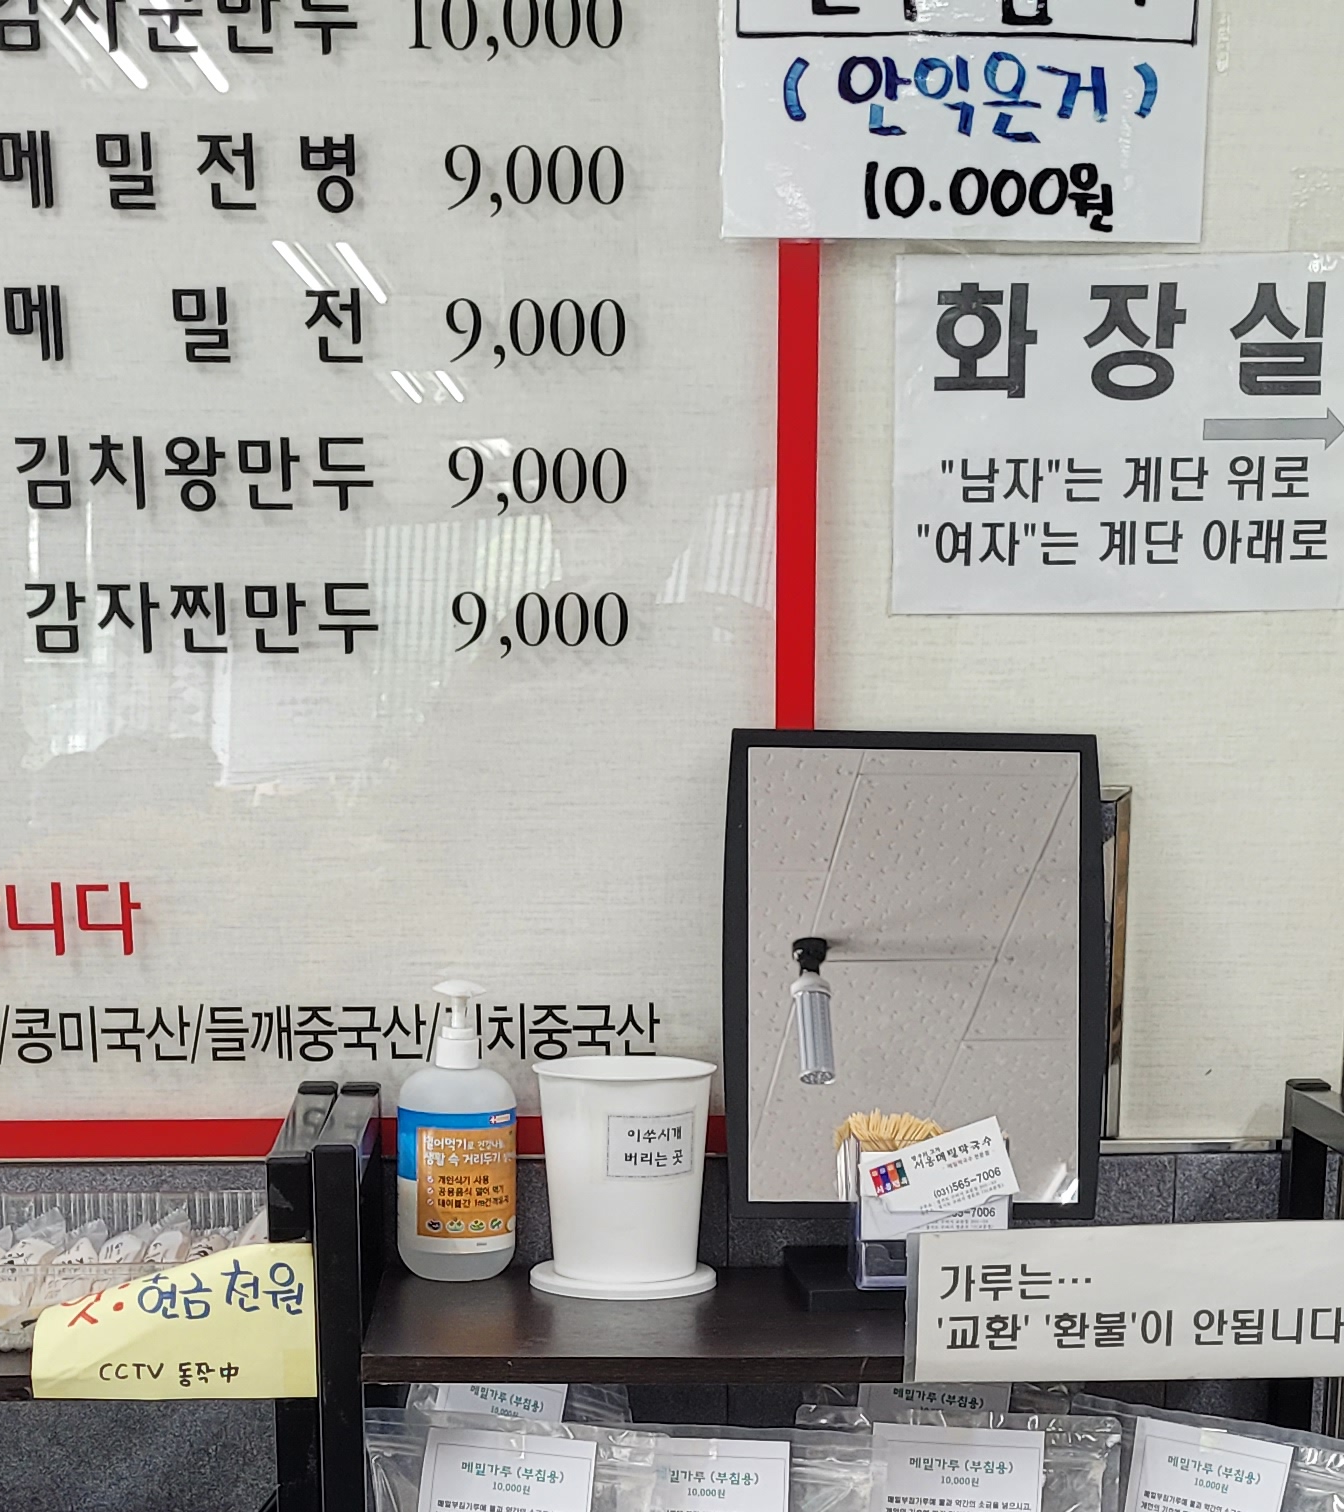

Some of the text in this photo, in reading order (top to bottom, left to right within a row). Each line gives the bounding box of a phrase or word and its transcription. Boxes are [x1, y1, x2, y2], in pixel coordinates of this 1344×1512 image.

[407, 0, 624, 60] 10,000
[444, 145, 626, 215] 9,000
[445, 298, 628, 369] 9,000
[14, 434, 629, 516] 김치왕만두 9,000
[940, 455, 1310, 504] "남자"는 계단 위로
[916, 517, 1328, 566] "여자"는 계단 아래로
[24, 581, 631, 660] 감자찐만두 9,000
[627, 1125, 683, 1144] 이쑤시개
[623, 1148, 684, 1168] 버리는 곳
[137, 1272, 213, 1320] 현금
[220, 1258, 304, 1316] 천원
[1193, 1307, 1344, 1347] 안됩니다
[98, 1362, 165, 1381] CCTV
[461, 1461, 565, 1484] 메밀가루 (부침용)
[709, 1470, 760, 1486] (부침용)
[908, 1457, 1014, 1475] 메밀가루 (부침용)
[1217, 1464, 1262, 1486] (부침용)
